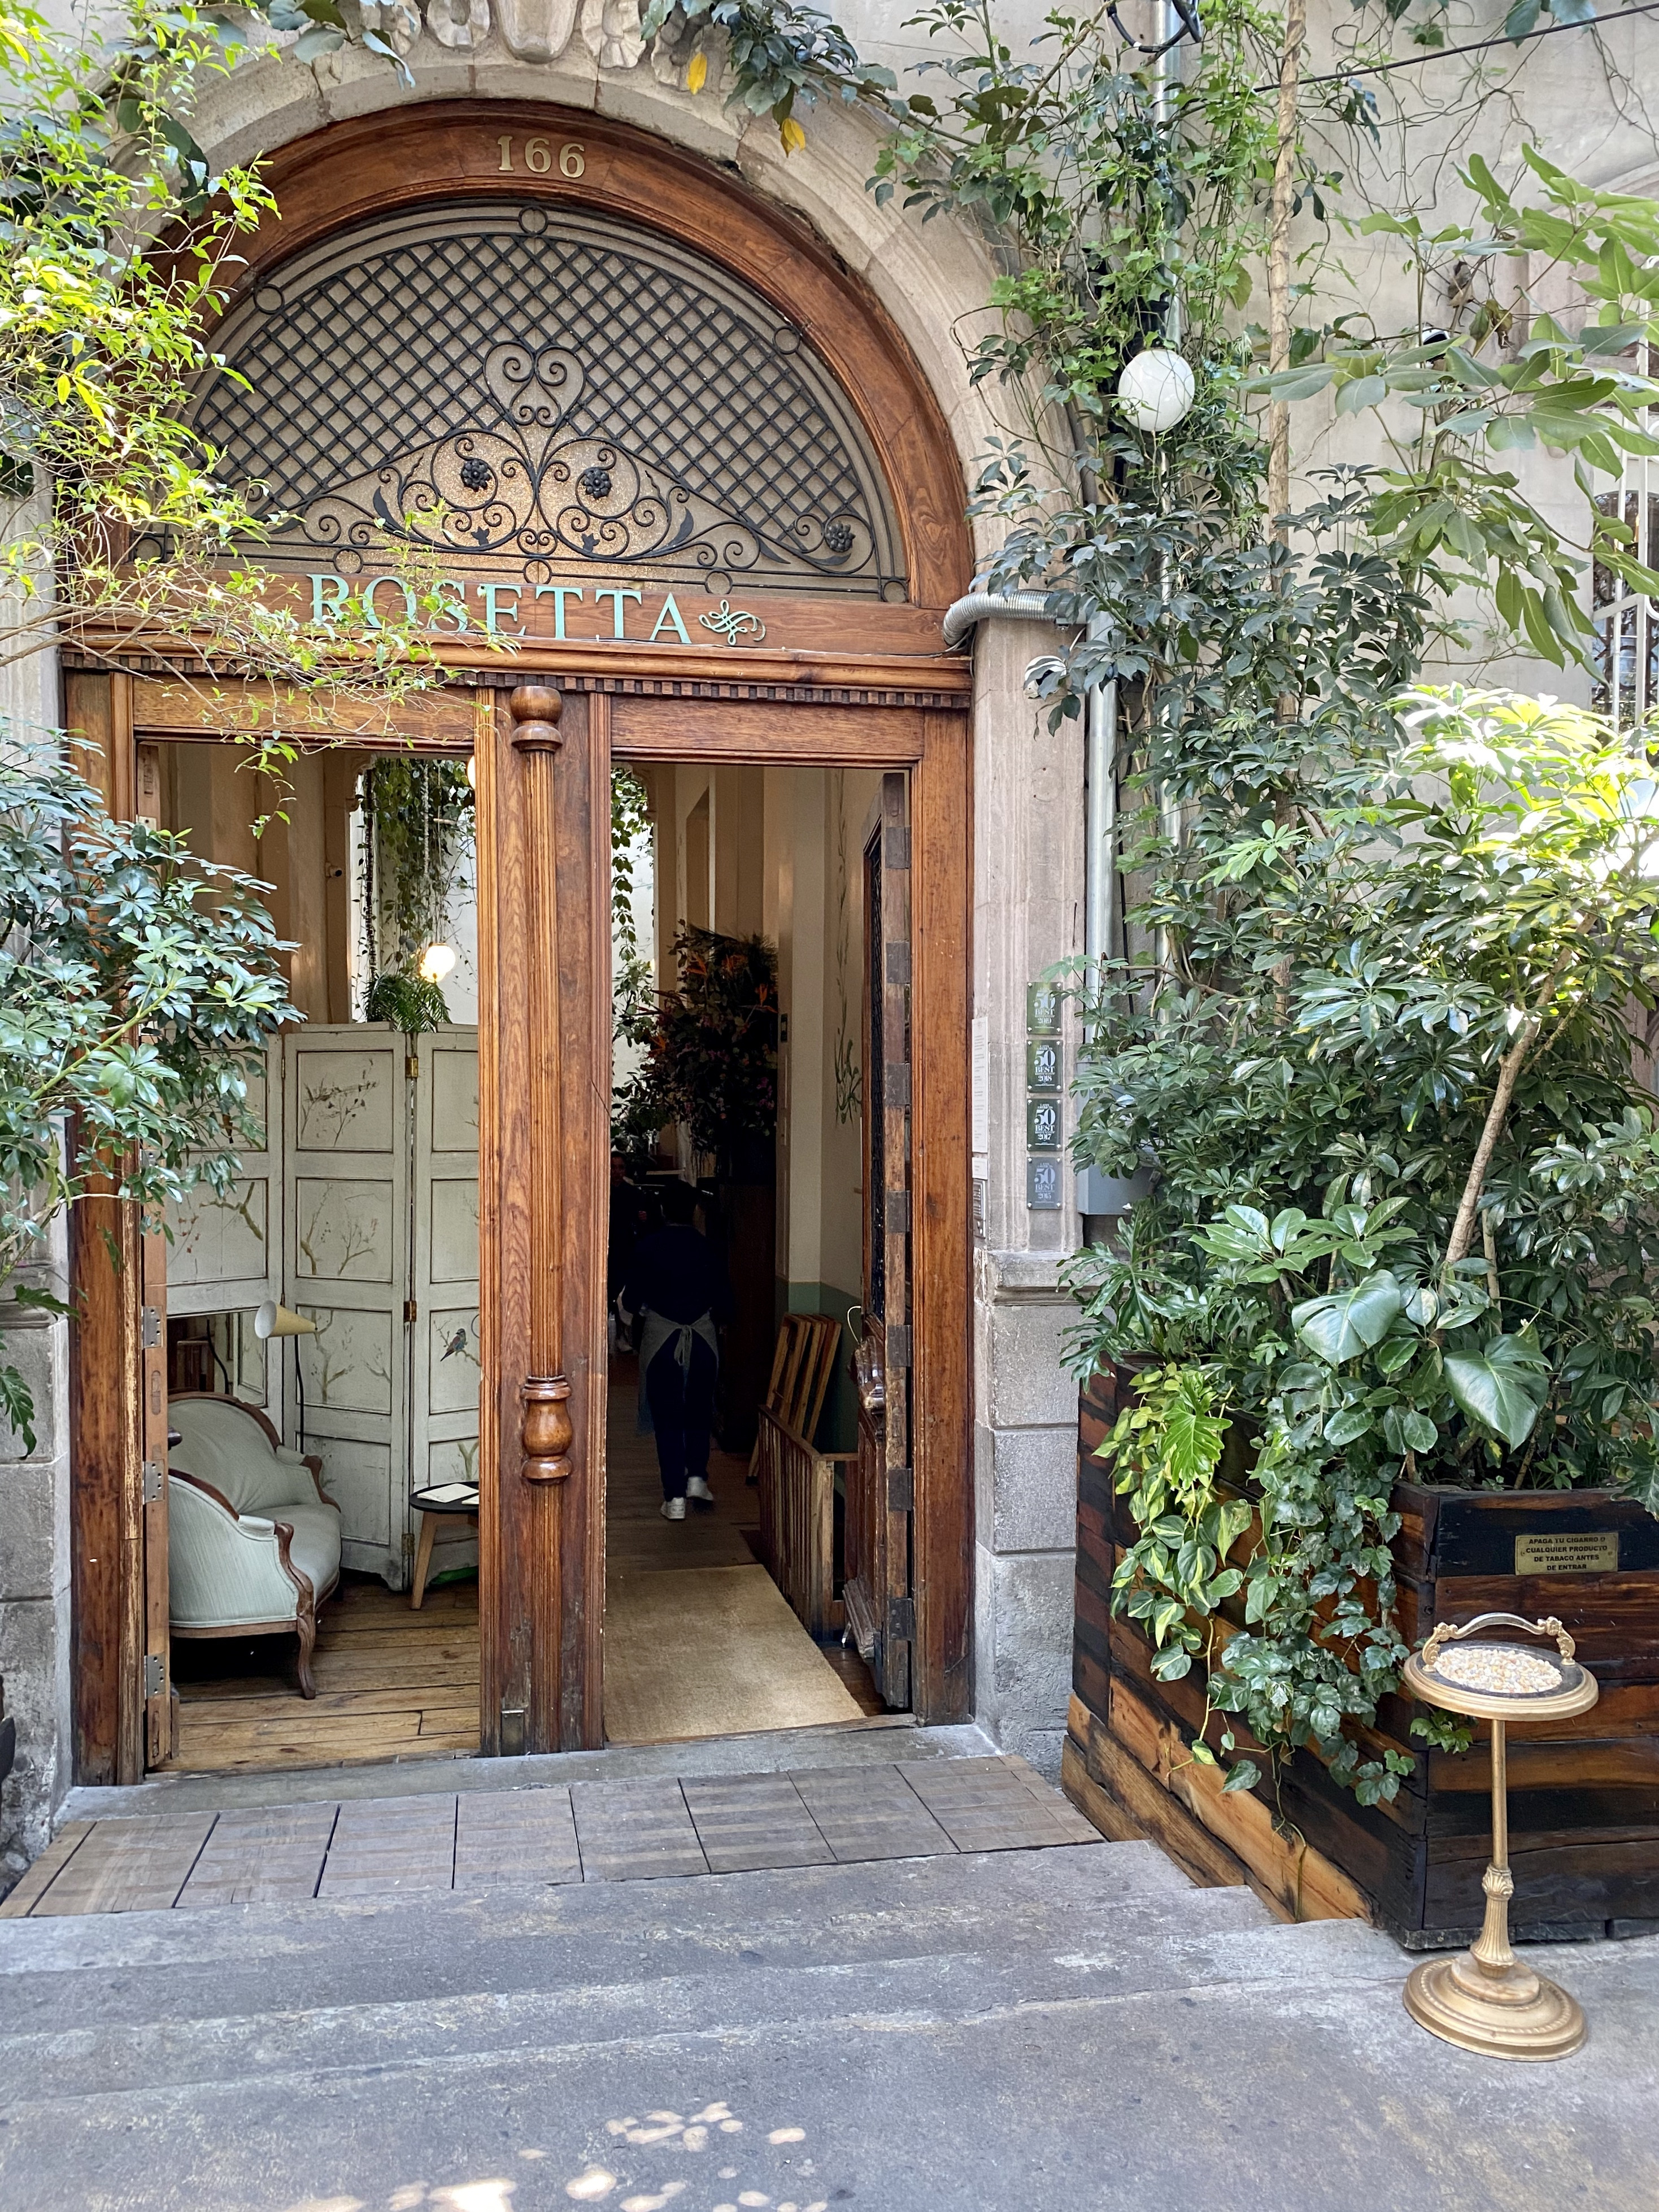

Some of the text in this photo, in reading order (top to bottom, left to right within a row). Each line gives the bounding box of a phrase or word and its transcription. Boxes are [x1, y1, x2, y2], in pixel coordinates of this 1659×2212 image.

[498, 135, 585, 178] 166
[306, 574, 692, 645] ROSETTA
[1034, 1050, 1056, 1066] 50
[1034, 1109, 1056, 1125] 50
[1034, 1168, 1056, 1184] 50
